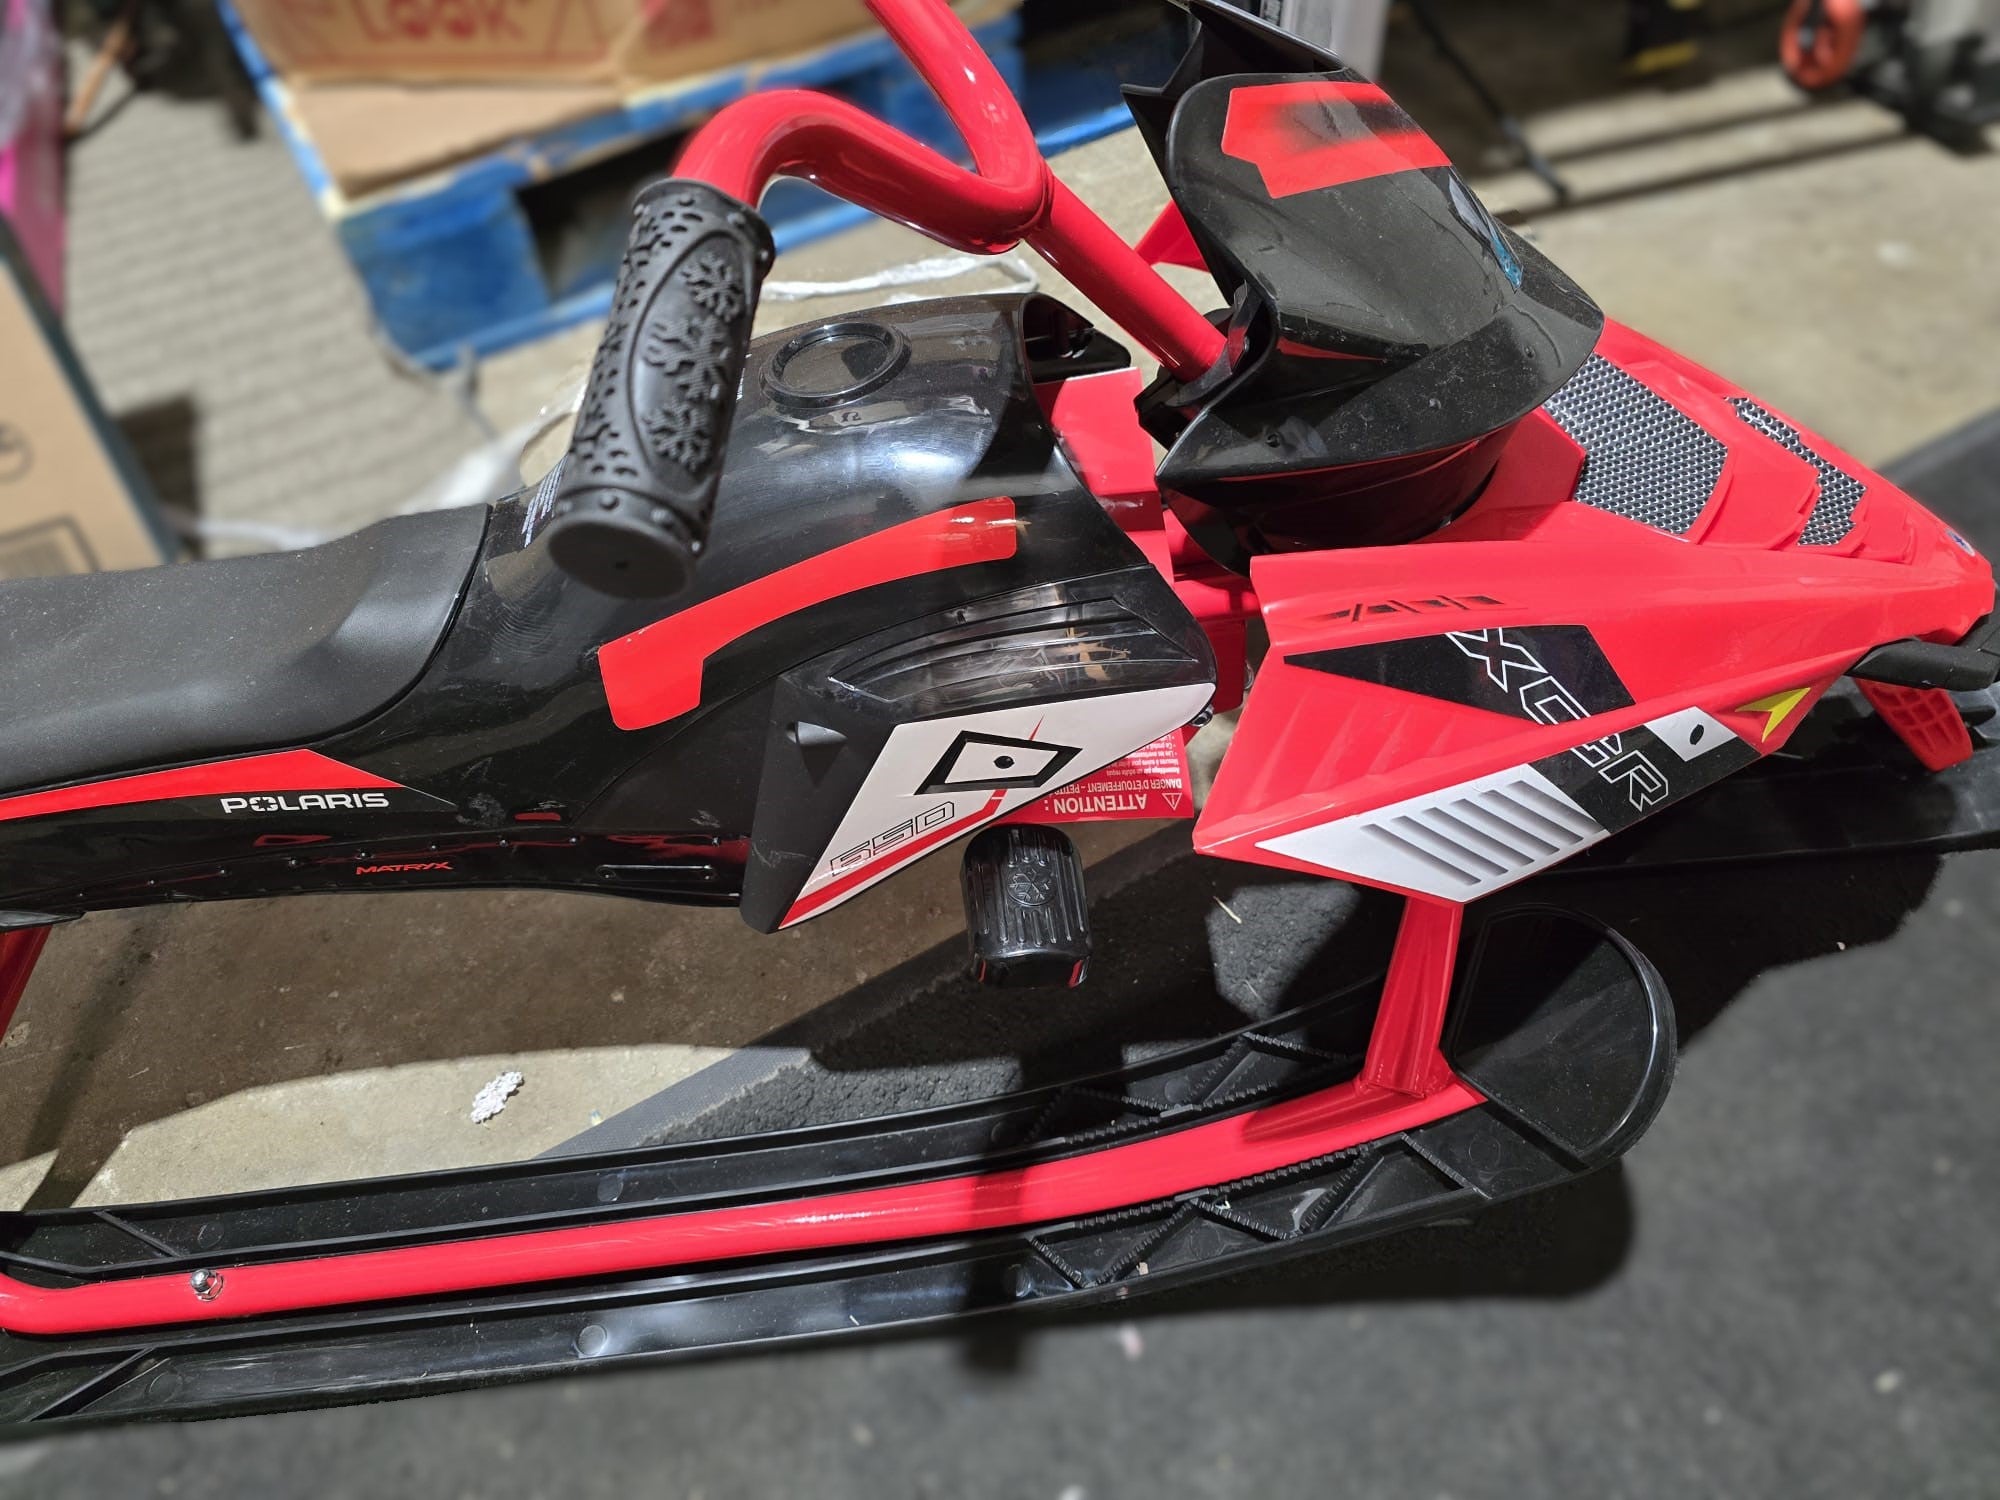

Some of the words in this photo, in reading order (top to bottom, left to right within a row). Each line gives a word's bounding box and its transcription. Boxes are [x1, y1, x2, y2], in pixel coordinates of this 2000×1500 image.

[1087, 779, 1150, 792] D'ÉTOUFFEMENT
[1151, 778, 1182, 789] DANGER
[220, 792, 390, 814] POLARIS
[1054, 794, 1147, 814] ATTENTION
[830, 801, 955, 877] 650
[356, 861, 453, 875] MATRYX
